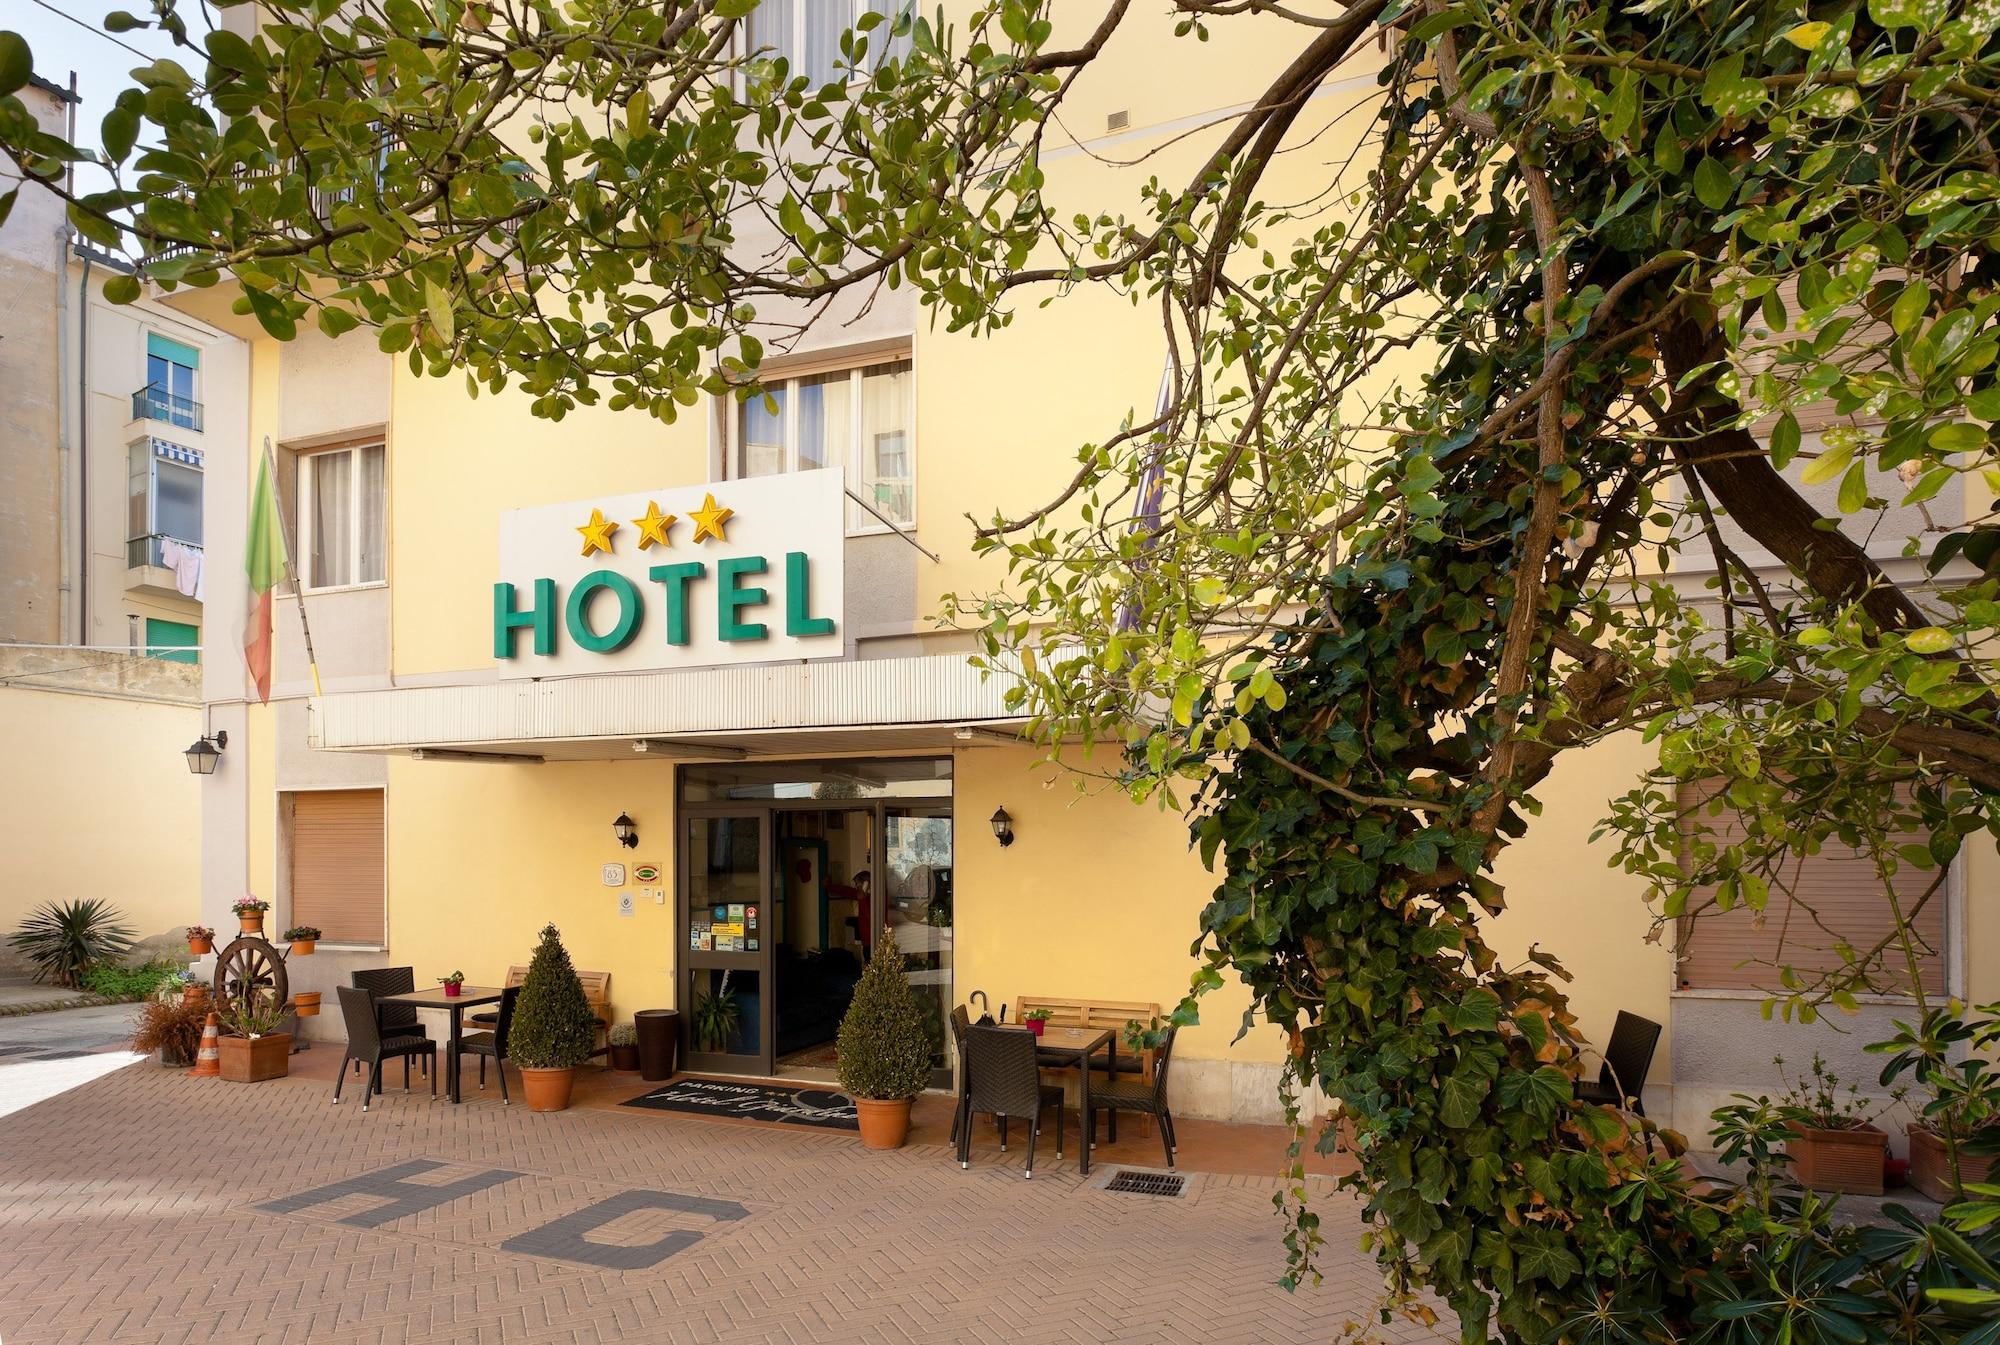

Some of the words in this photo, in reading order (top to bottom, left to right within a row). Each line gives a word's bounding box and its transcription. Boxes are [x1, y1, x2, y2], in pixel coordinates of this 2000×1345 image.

[494, 552, 836, 659] HOTEL
[678, 1081, 760, 1094] PARKING
[646, 1090, 761, 1106] Hotel
